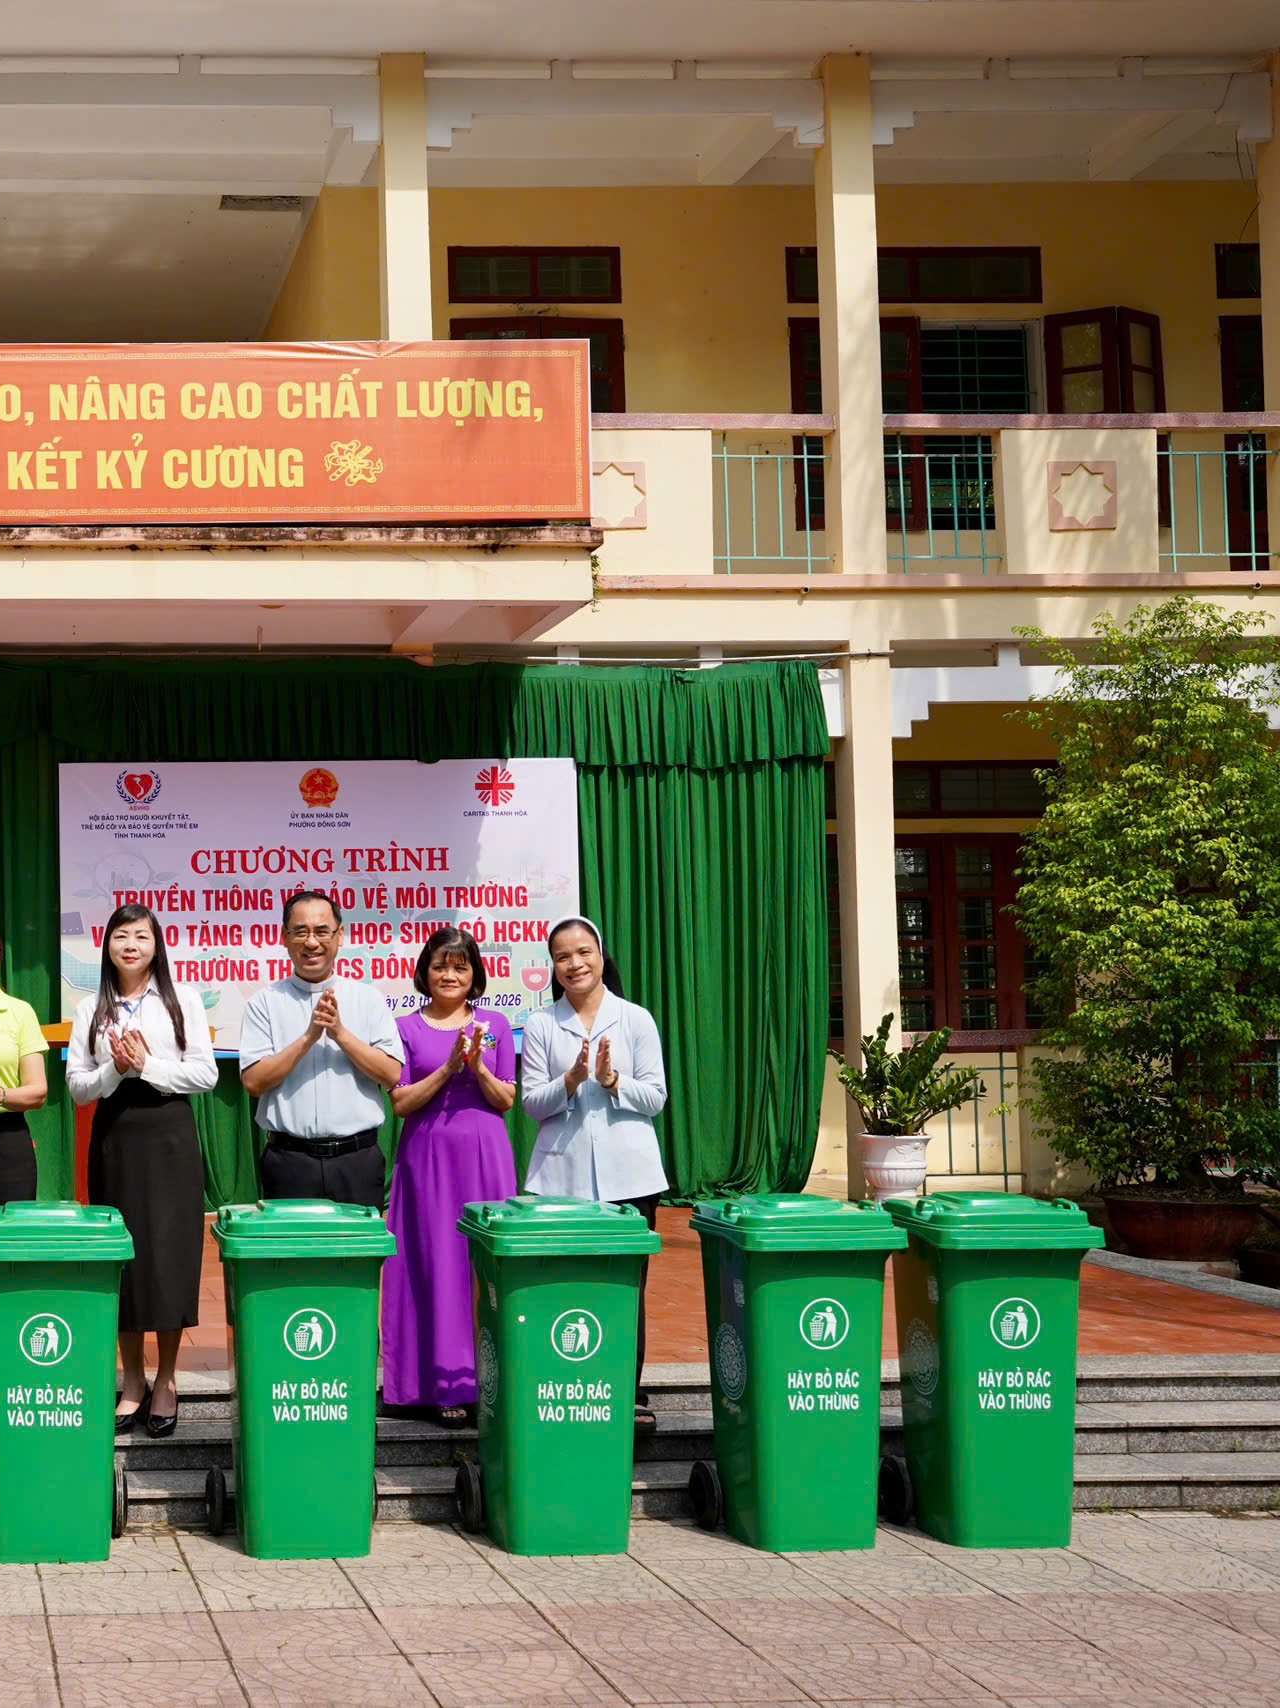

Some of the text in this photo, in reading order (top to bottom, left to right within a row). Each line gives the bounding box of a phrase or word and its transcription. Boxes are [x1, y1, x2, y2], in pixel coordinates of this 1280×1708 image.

[49, 376, 166, 420] NÂNG
[181, 381, 263, 420] CAO
[278, 368, 384, 419] CHẤT
[396, 377, 544, 426] LƯỢNG,
[8, 437, 83, 490] KẾT
[97, 433, 149, 488] KỶ
[163, 445, 305, 488] CƯƠNG
[101, 813, 114, 821] BẢO
[128, 822, 142, 830] BẢO
[317, 820, 336, 828] ĐÔNG
[191, 841, 450, 875] CHƯƠNG TRÌNH
[113, 883, 196, 912] TRUYỀN
[202, 884, 273, 912] THÔNG
[362, 883, 388, 914] VỆ
[395, 882, 436, 909] MÔI
[443, 881, 528, 909] TRƯỜNG
[91, 926, 105, 948] V
[186, 920, 243, 952] TẶNG
[250, 924, 285, 949] QU
[350, 922, 393, 950] HỌC
[493, 920, 550, 943] HCKK
[173, 955, 259, 982] TRƯỜNG
[371, 953, 417, 980] ĐÔN
[401, 995, 416, 1008] 28
[494, 994, 521, 1007] 2026
[787, 1367, 860, 1389] HÃY BỎ RÁC
[978, 1366, 1052, 1388] HÃY BỎ RÁC
[7, 1383, 83, 1406] HÃY BỎ RÁC
[272, 1377, 348, 1400] HÃY BỎ RÁC
[537, 1378, 612, 1401] HÃY BỎ RÁC
[978, 1389, 1052, 1410] VÀO THÙNG
[272, 1401, 348, 1422] VÀO THÙNG
[537, 1401, 611, 1423] VÀO THÙNG
[787, 1391, 860, 1411] VÀO THÙNG
[7, 1406, 83, 1428] VÀO THÙNG
